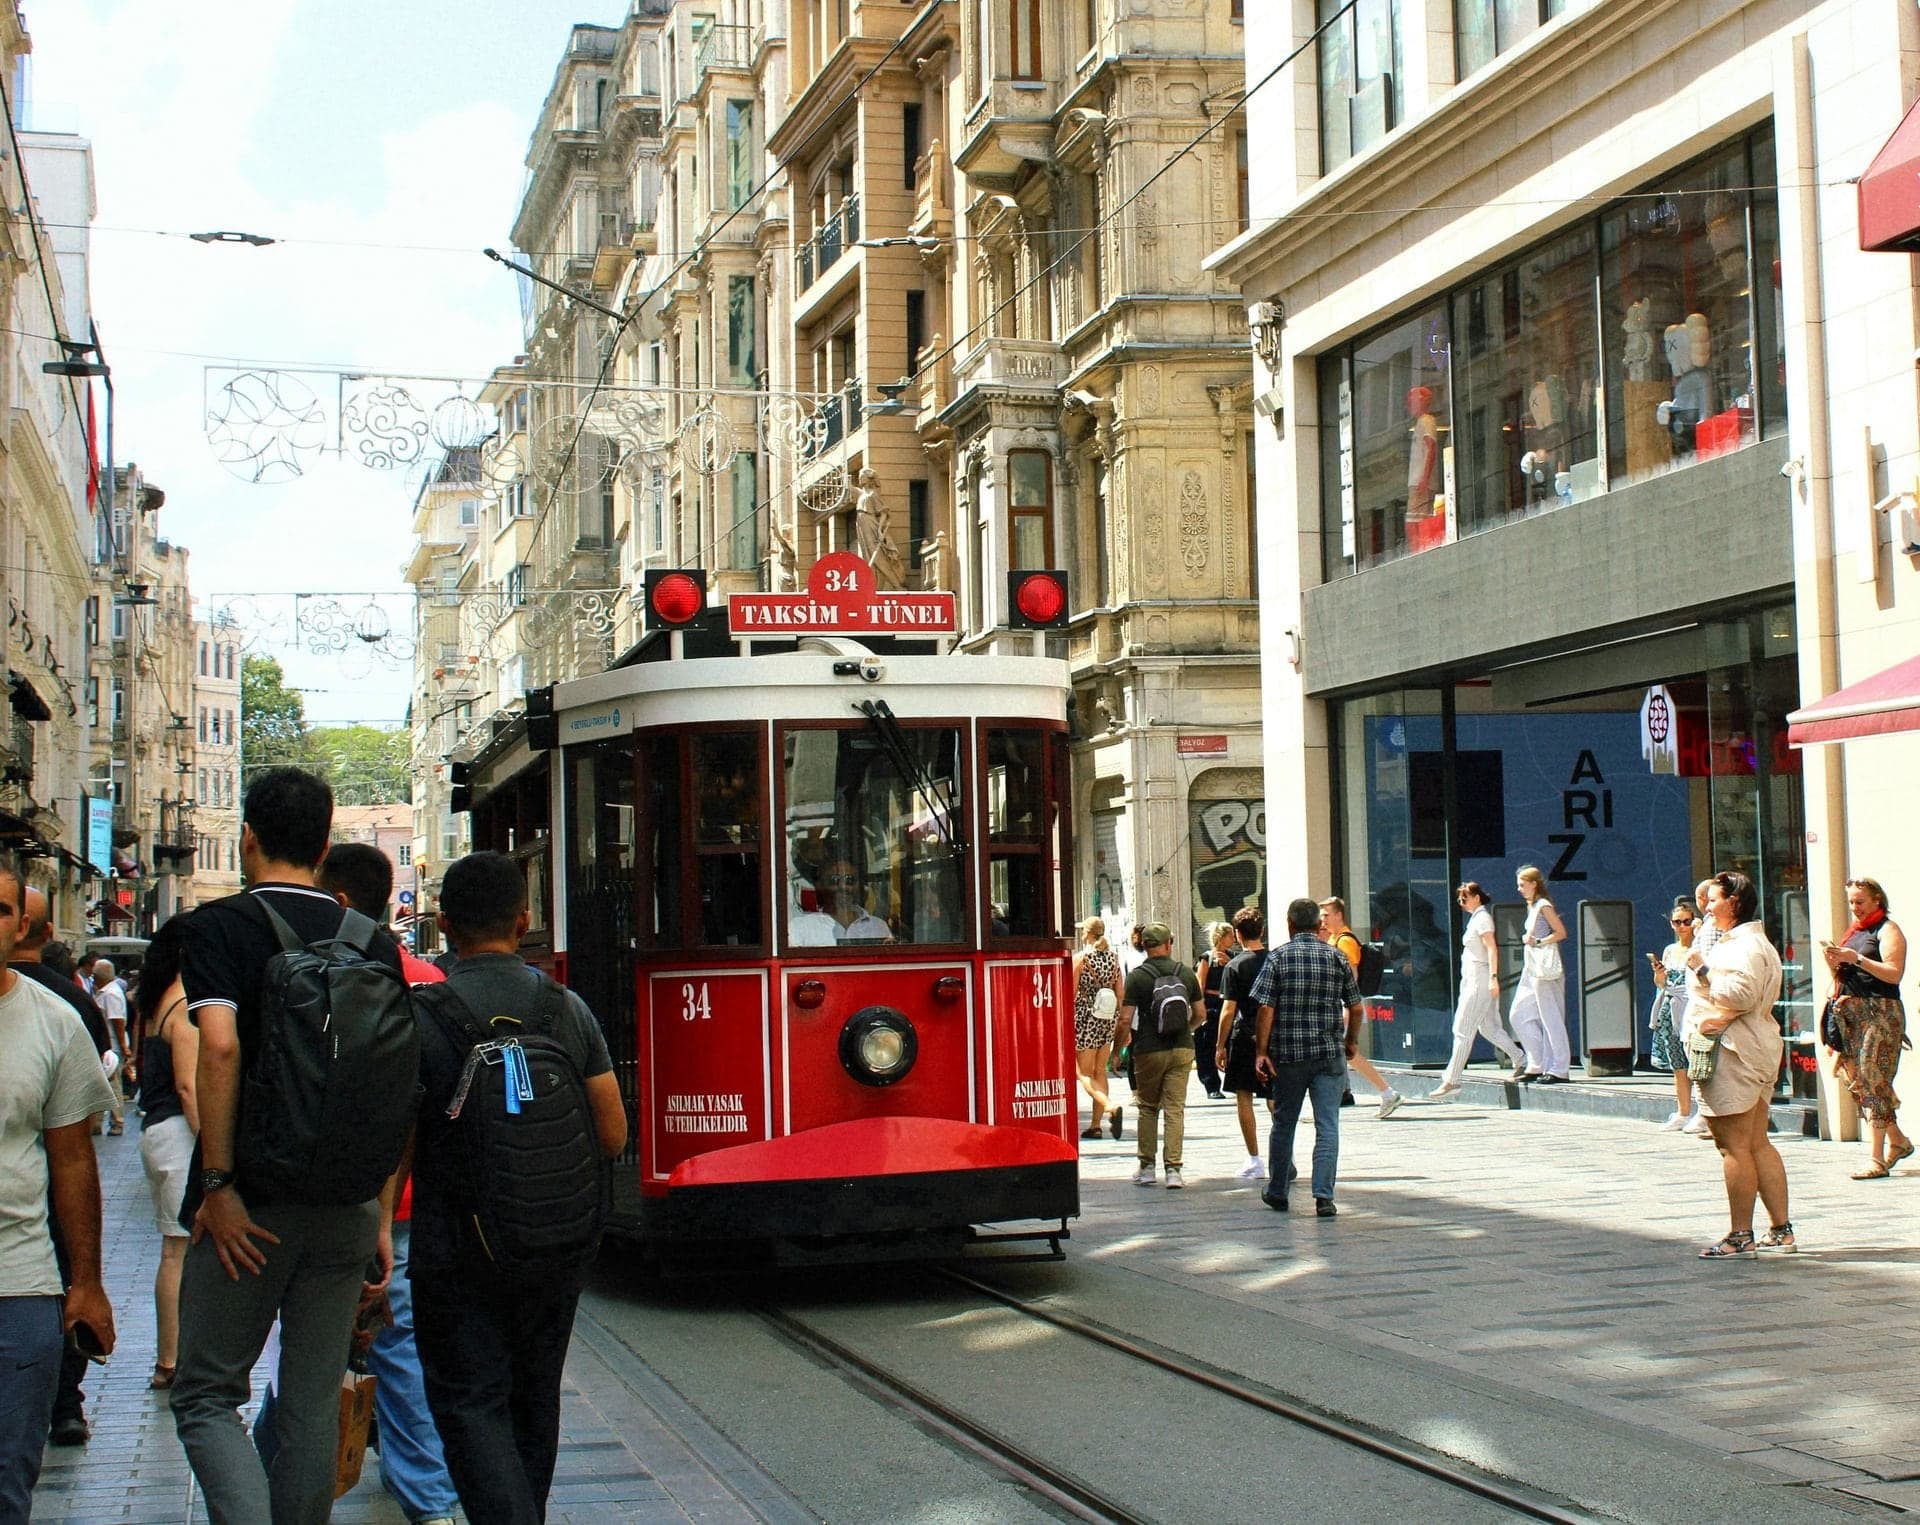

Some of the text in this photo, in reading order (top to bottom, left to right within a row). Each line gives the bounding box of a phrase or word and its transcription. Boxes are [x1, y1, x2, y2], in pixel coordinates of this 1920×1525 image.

[825, 569, 859, 592] 34
[741, 599, 839, 624] TAKSİM
[867, 599, 948, 624] TÜNEL
[1571, 749, 1605, 784] A
[1564, 789, 1613, 828] RI
[683, 983, 711, 1021] 34
[1033, 972, 1052, 1008] 34
[1014, 1080, 1051, 1098] ASILMAK
[666, 1094, 744, 1112] ASILMAK YASAK
[1012, 1102, 1025, 1119] VE
[664, 1115, 675, 1133] VE
